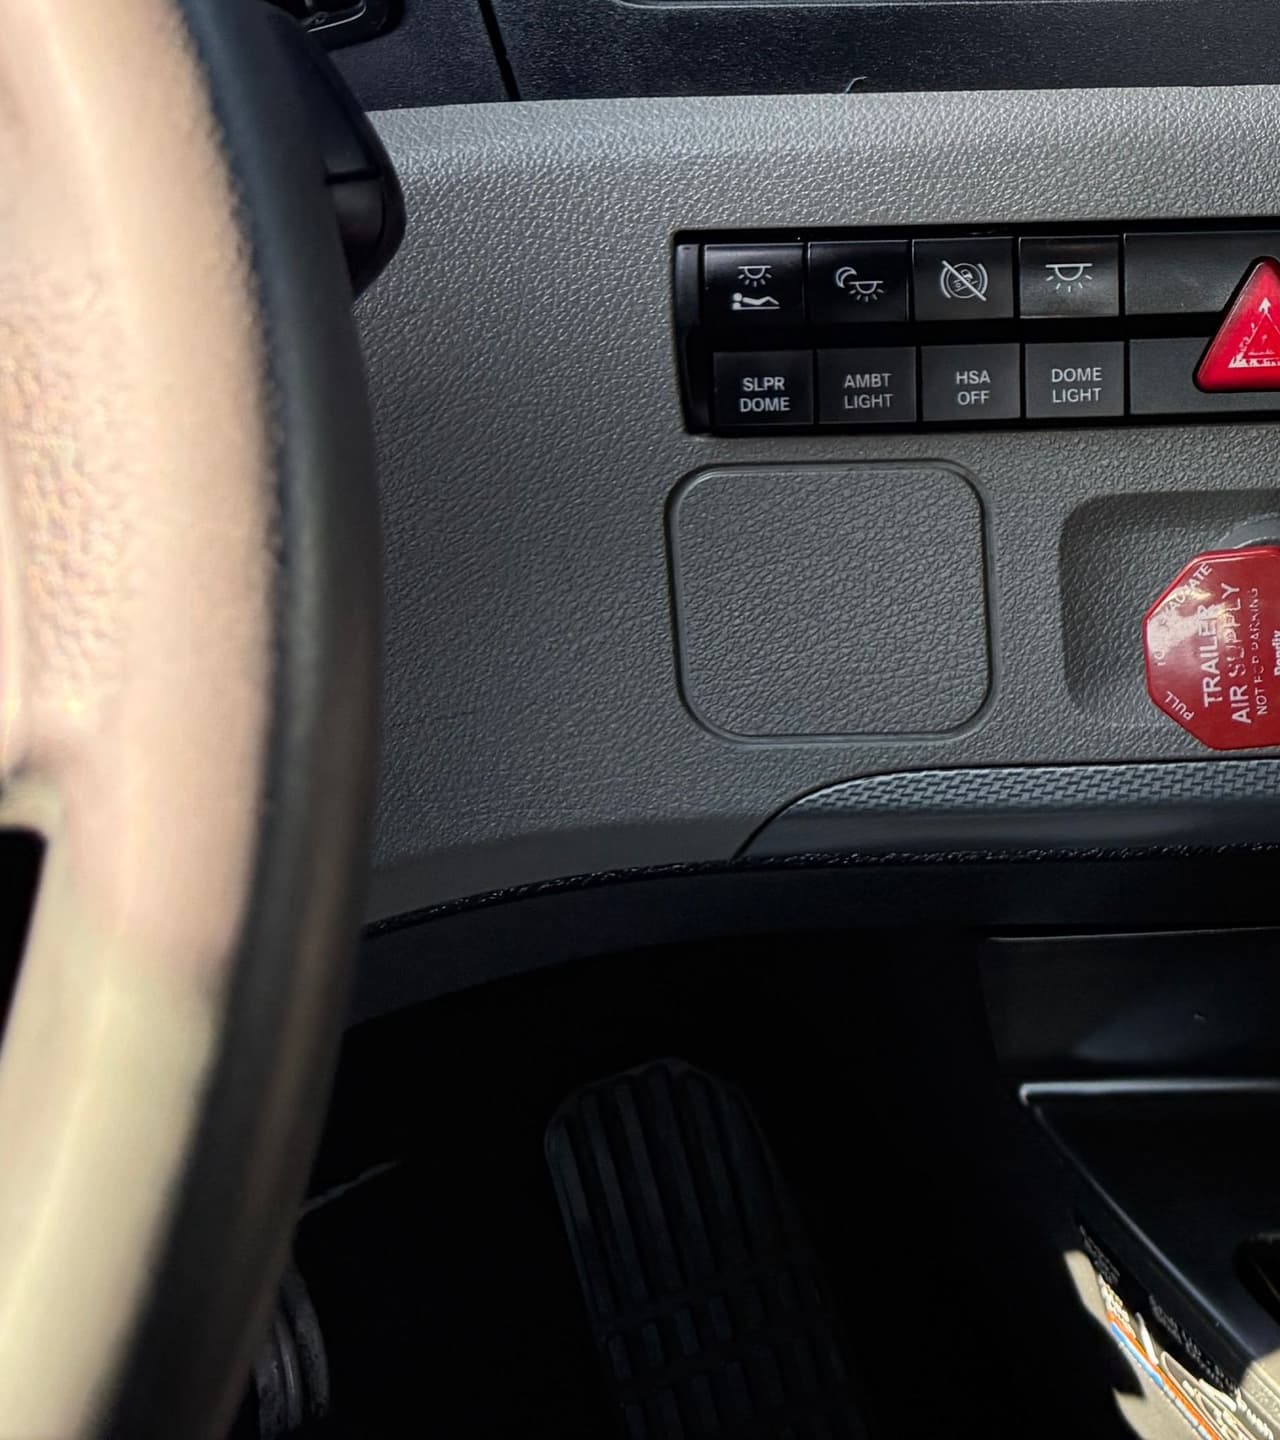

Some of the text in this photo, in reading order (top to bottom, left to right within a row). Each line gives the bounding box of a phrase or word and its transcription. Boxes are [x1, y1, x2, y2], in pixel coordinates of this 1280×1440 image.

[843, 373, 891, 389] AMBT
[955, 370, 991, 385] HSA
[1050, 367, 1103, 383] DOME
[742, 376, 786, 392] SLPR
[843, 392, 894, 409] LIGHT
[957, 389, 990, 406] OFF
[1052, 386, 1103, 403] LIGHT
[739, 395, 791, 412] DOME
[1199, 604, 1223, 707] TRAILER
[1166, 691, 1194, 721] PULL
[1229, 685, 1252, 723] AIR
[1254, 688, 1268, 715] NOT
